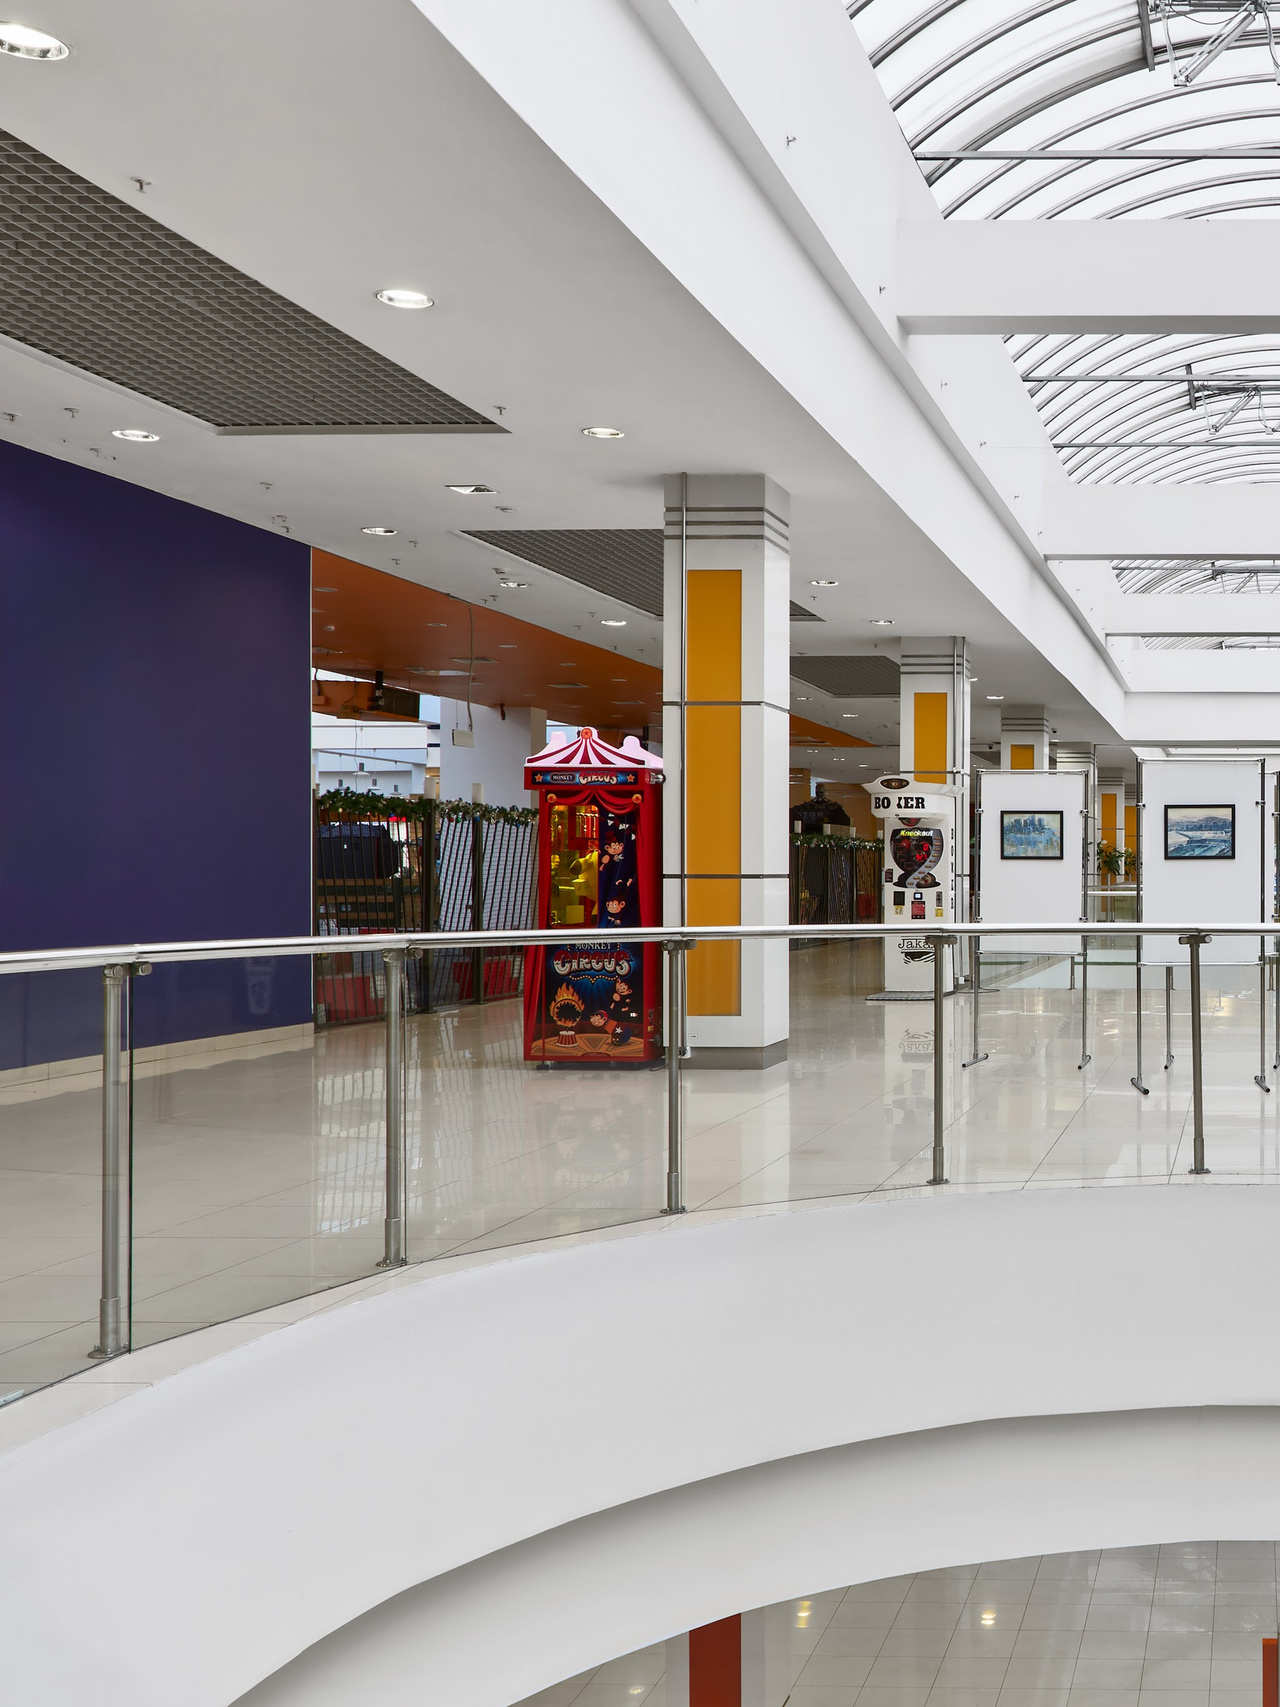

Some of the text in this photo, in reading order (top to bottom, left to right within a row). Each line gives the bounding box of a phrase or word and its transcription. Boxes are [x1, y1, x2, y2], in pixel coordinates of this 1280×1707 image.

[578, 771, 618, 785] CIRCUS
[575, 942, 612, 950] MONKEY
[898, 938, 935, 949] Jaka
[553, 950, 631, 976] CIRCUS
